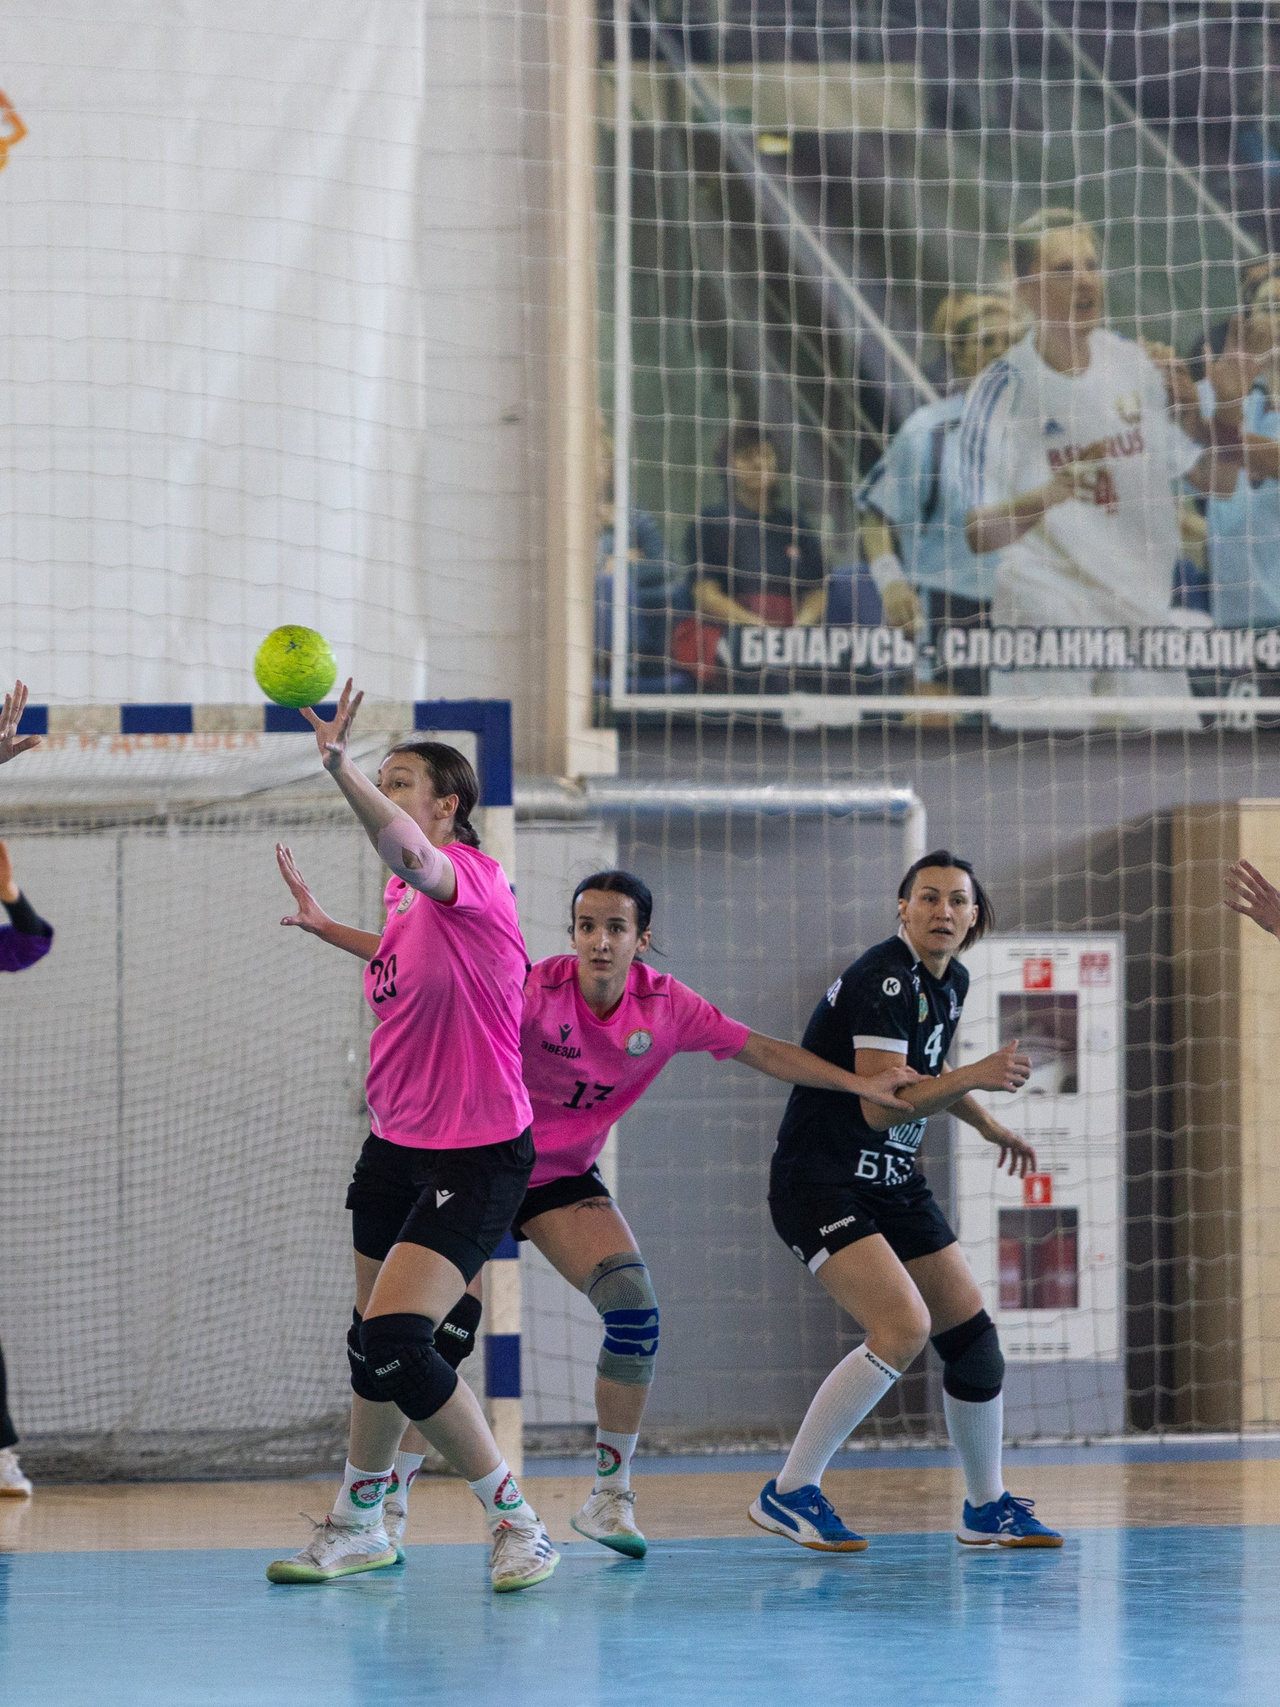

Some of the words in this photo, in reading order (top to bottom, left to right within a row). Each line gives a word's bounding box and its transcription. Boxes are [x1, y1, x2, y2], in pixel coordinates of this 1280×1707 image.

[740, 626, 914, 667] БЕЛАРУСЬ
[370, 954, 398, 1004] 20
[540, 1038, 582, 1060] ЗВЕЗДА
[924, 1022, 944, 1068] 4
[819, 1215, 856, 1237] Kempa
[443, 1322, 470, 1339] SELECT
[375, 1359, 401, 1376] SELECT
